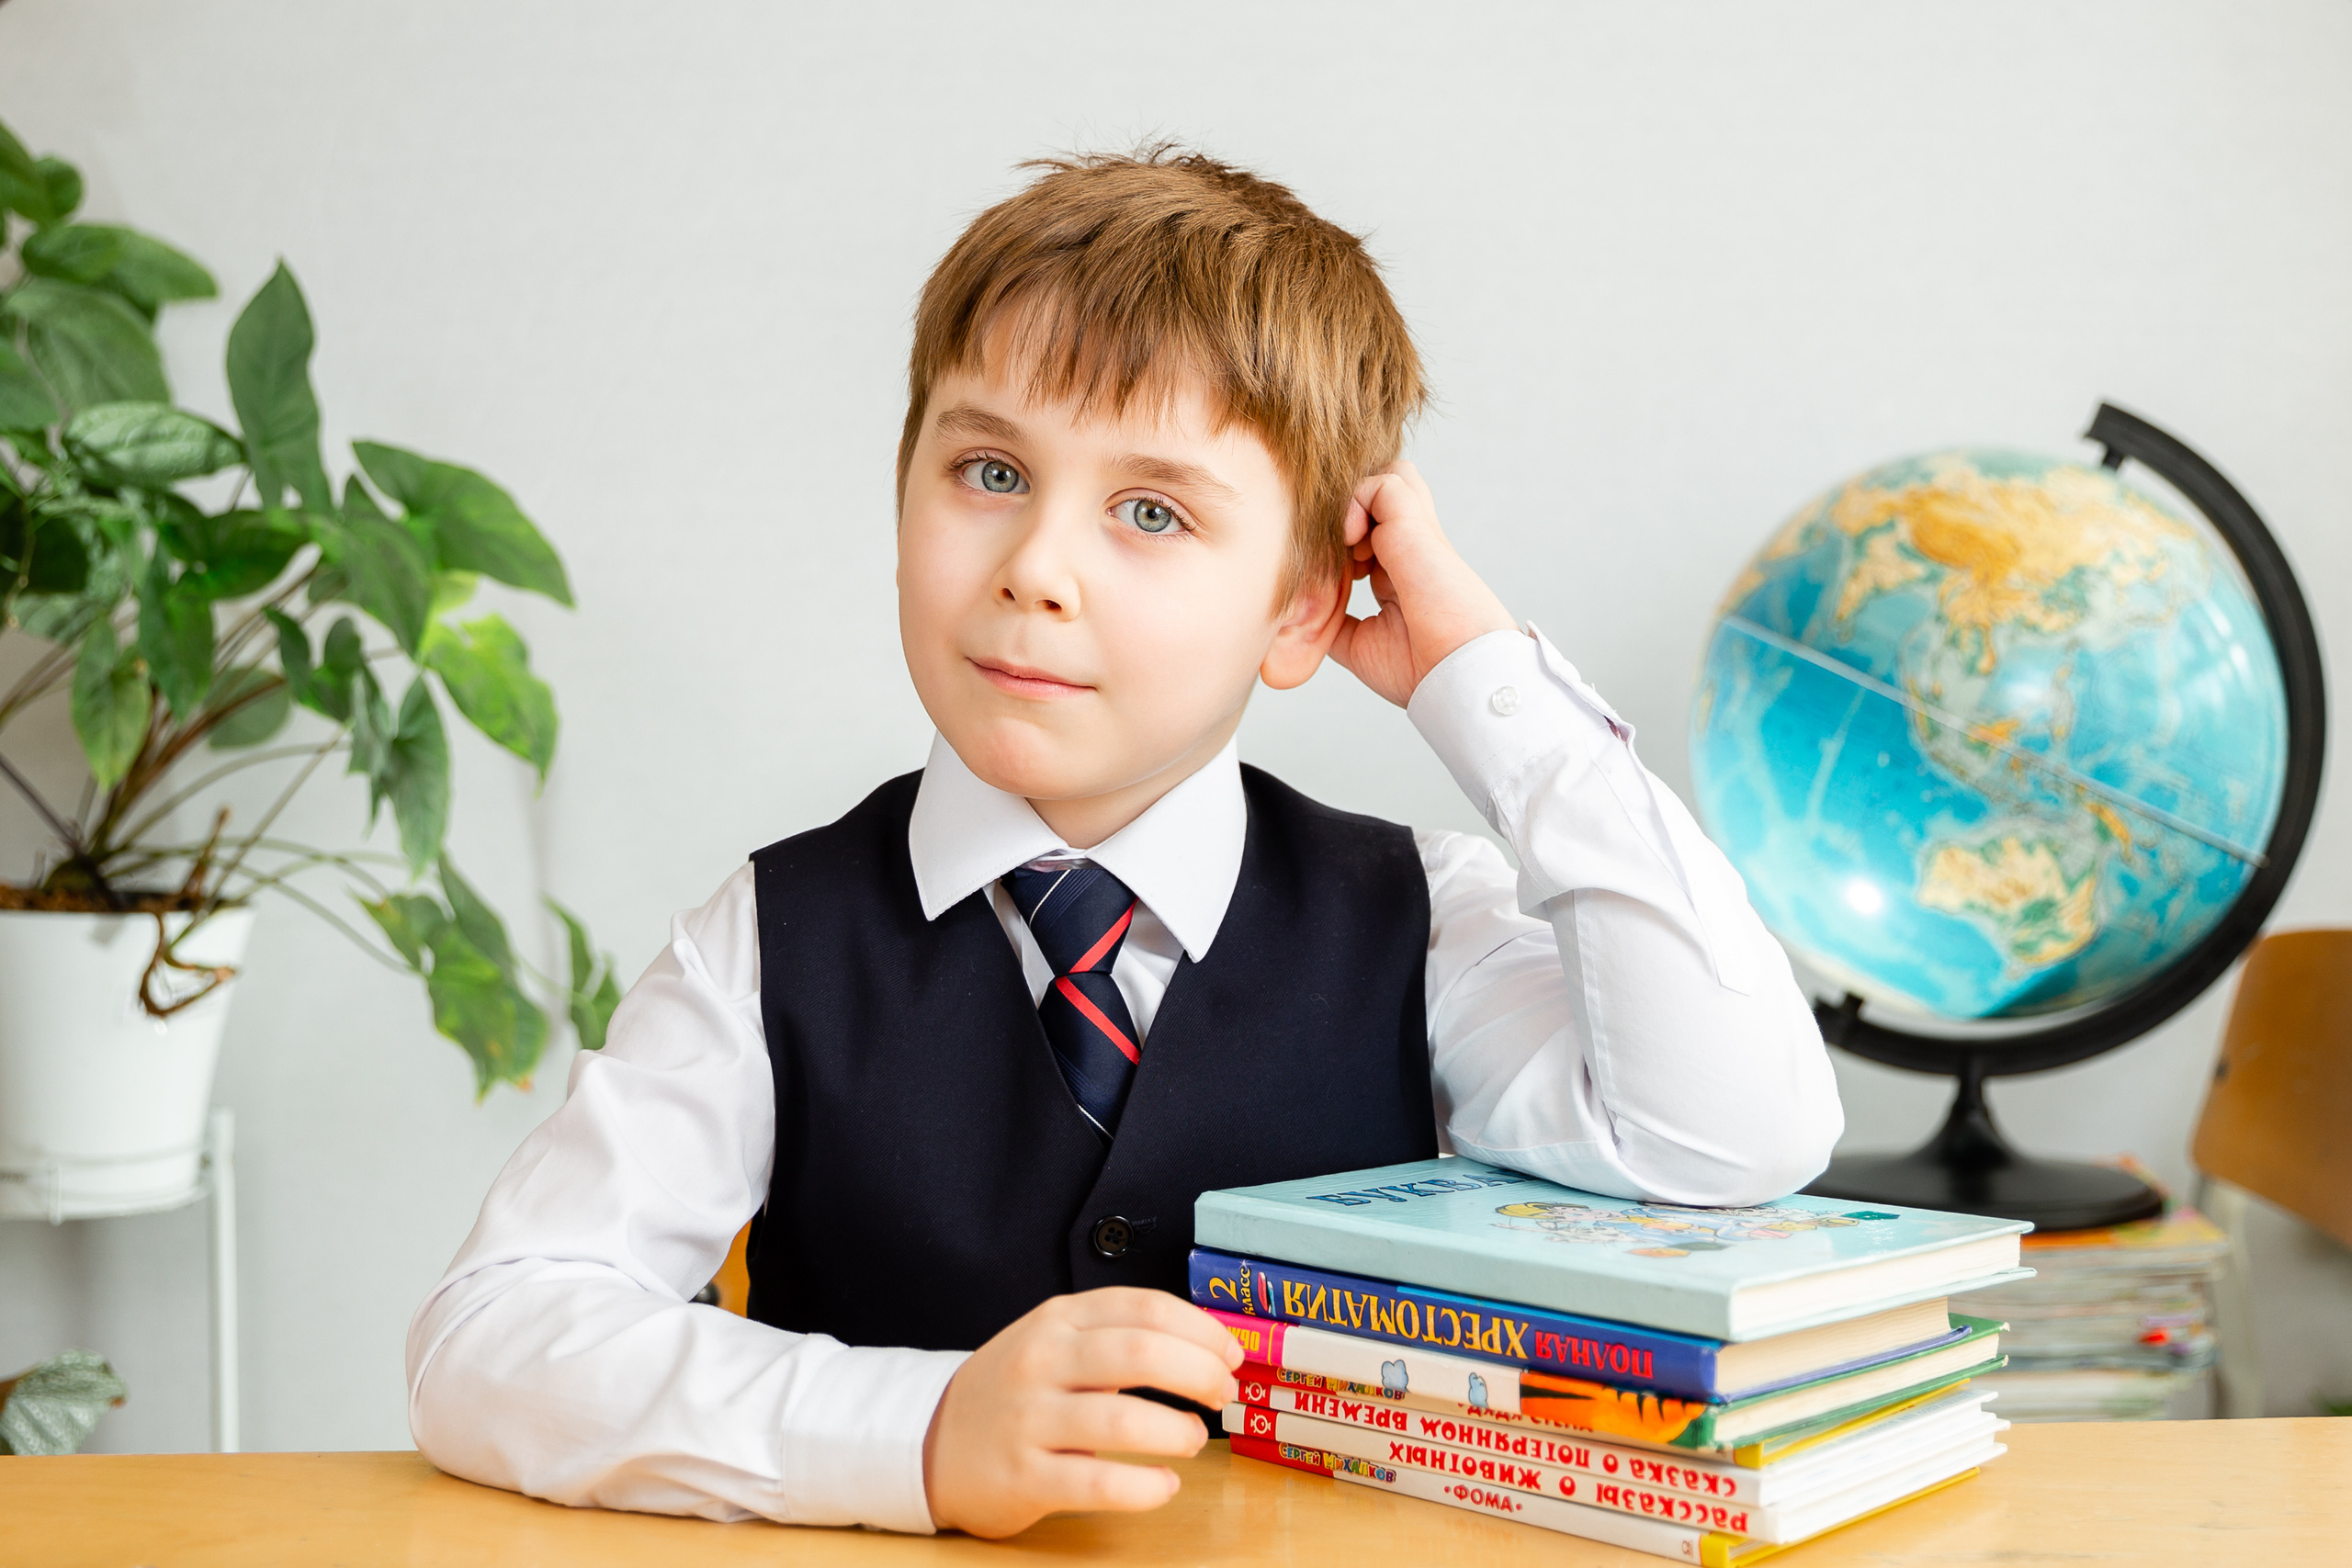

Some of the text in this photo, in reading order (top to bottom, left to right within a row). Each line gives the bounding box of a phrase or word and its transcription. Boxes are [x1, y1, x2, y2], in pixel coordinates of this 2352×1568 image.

[1209, 1276, 1238, 1303] 2
[1282, 1280, 1653, 1379] ПОЛНАЯ ХРЕСТОМАТИЯ
[1276, 1367, 1325, 1389] СЕРГЕЙ
[1279, 1441, 1396, 1483] СЕРГЕЙ МИХАЛКОВ
